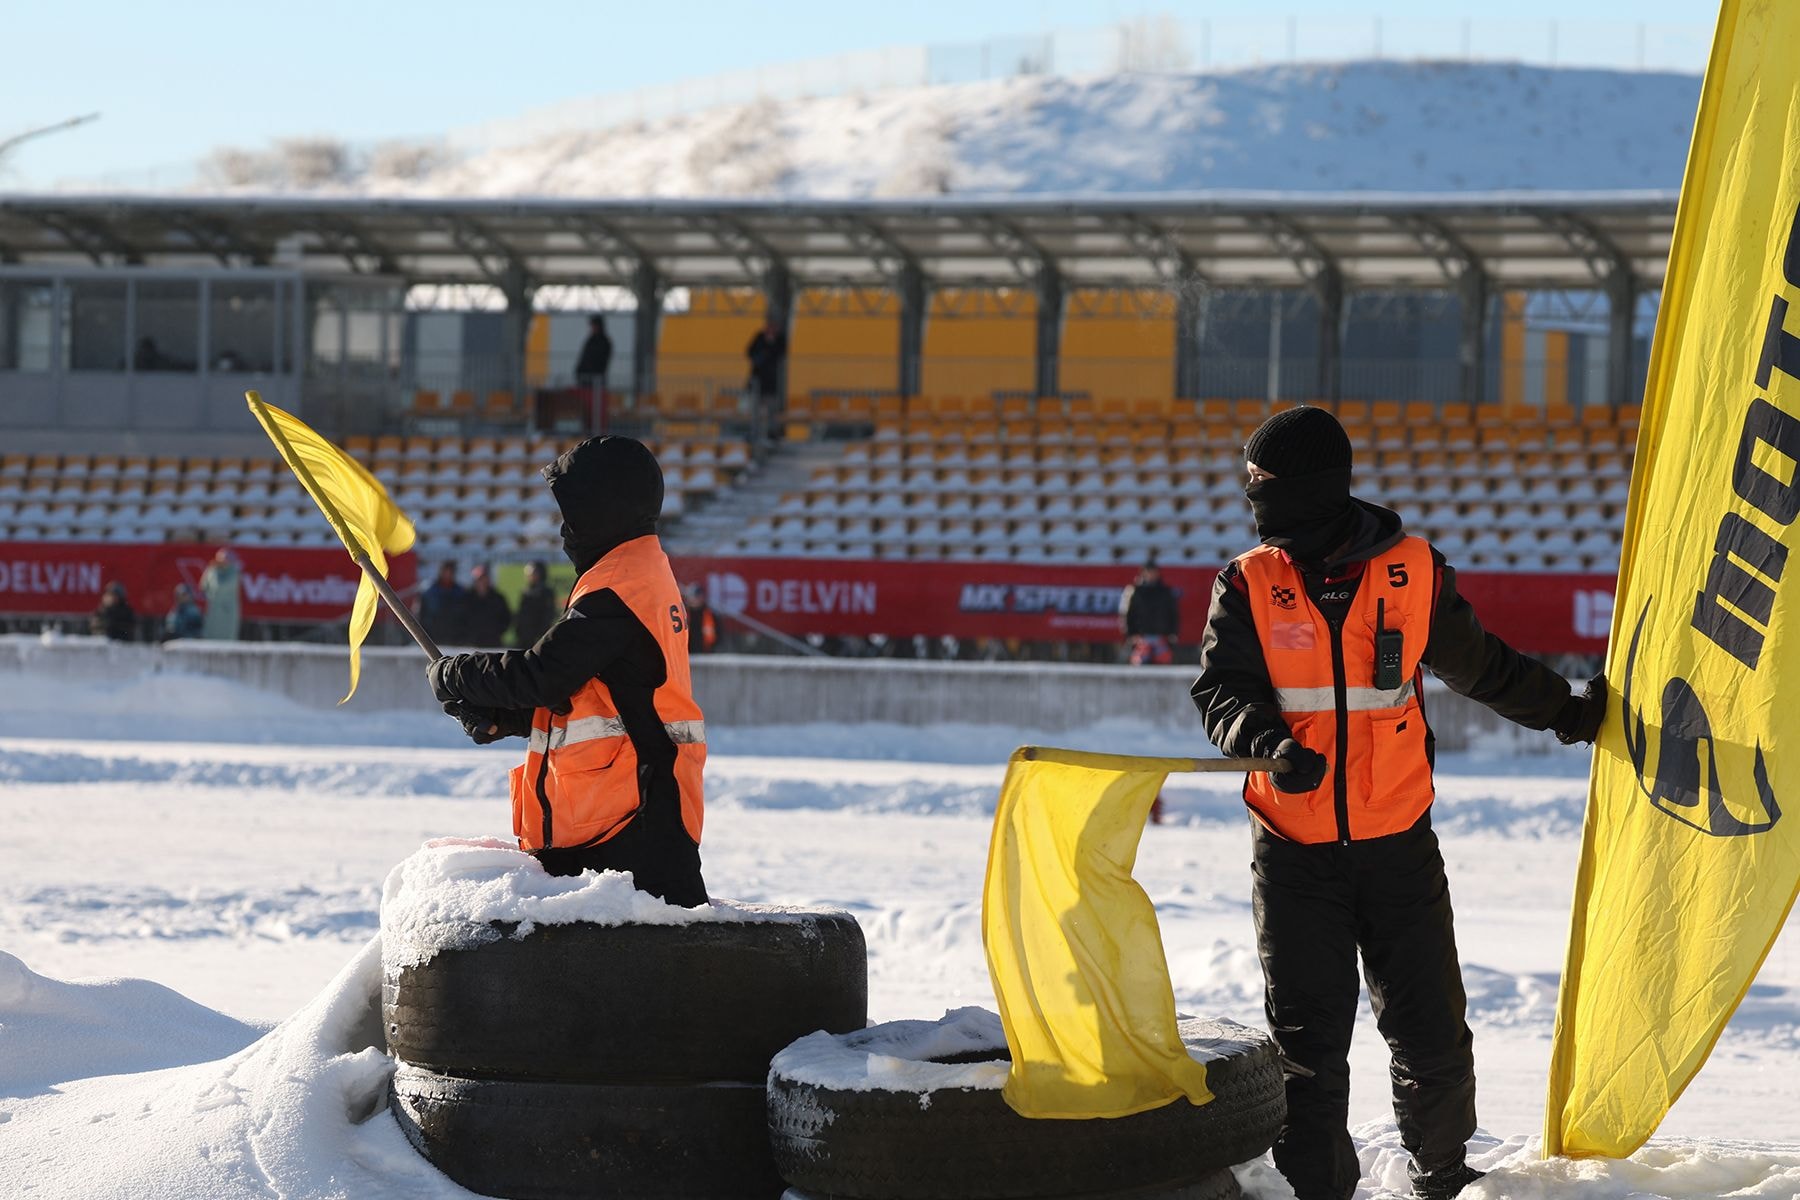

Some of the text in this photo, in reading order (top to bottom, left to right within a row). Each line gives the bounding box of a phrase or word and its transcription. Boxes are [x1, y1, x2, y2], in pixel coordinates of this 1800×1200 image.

[241, 572, 357, 604] Valvolin
[1387, 563, 1409, 588] 5
[960, 584, 1006, 612] MX
[1320, 591, 1350, 601] RLG
